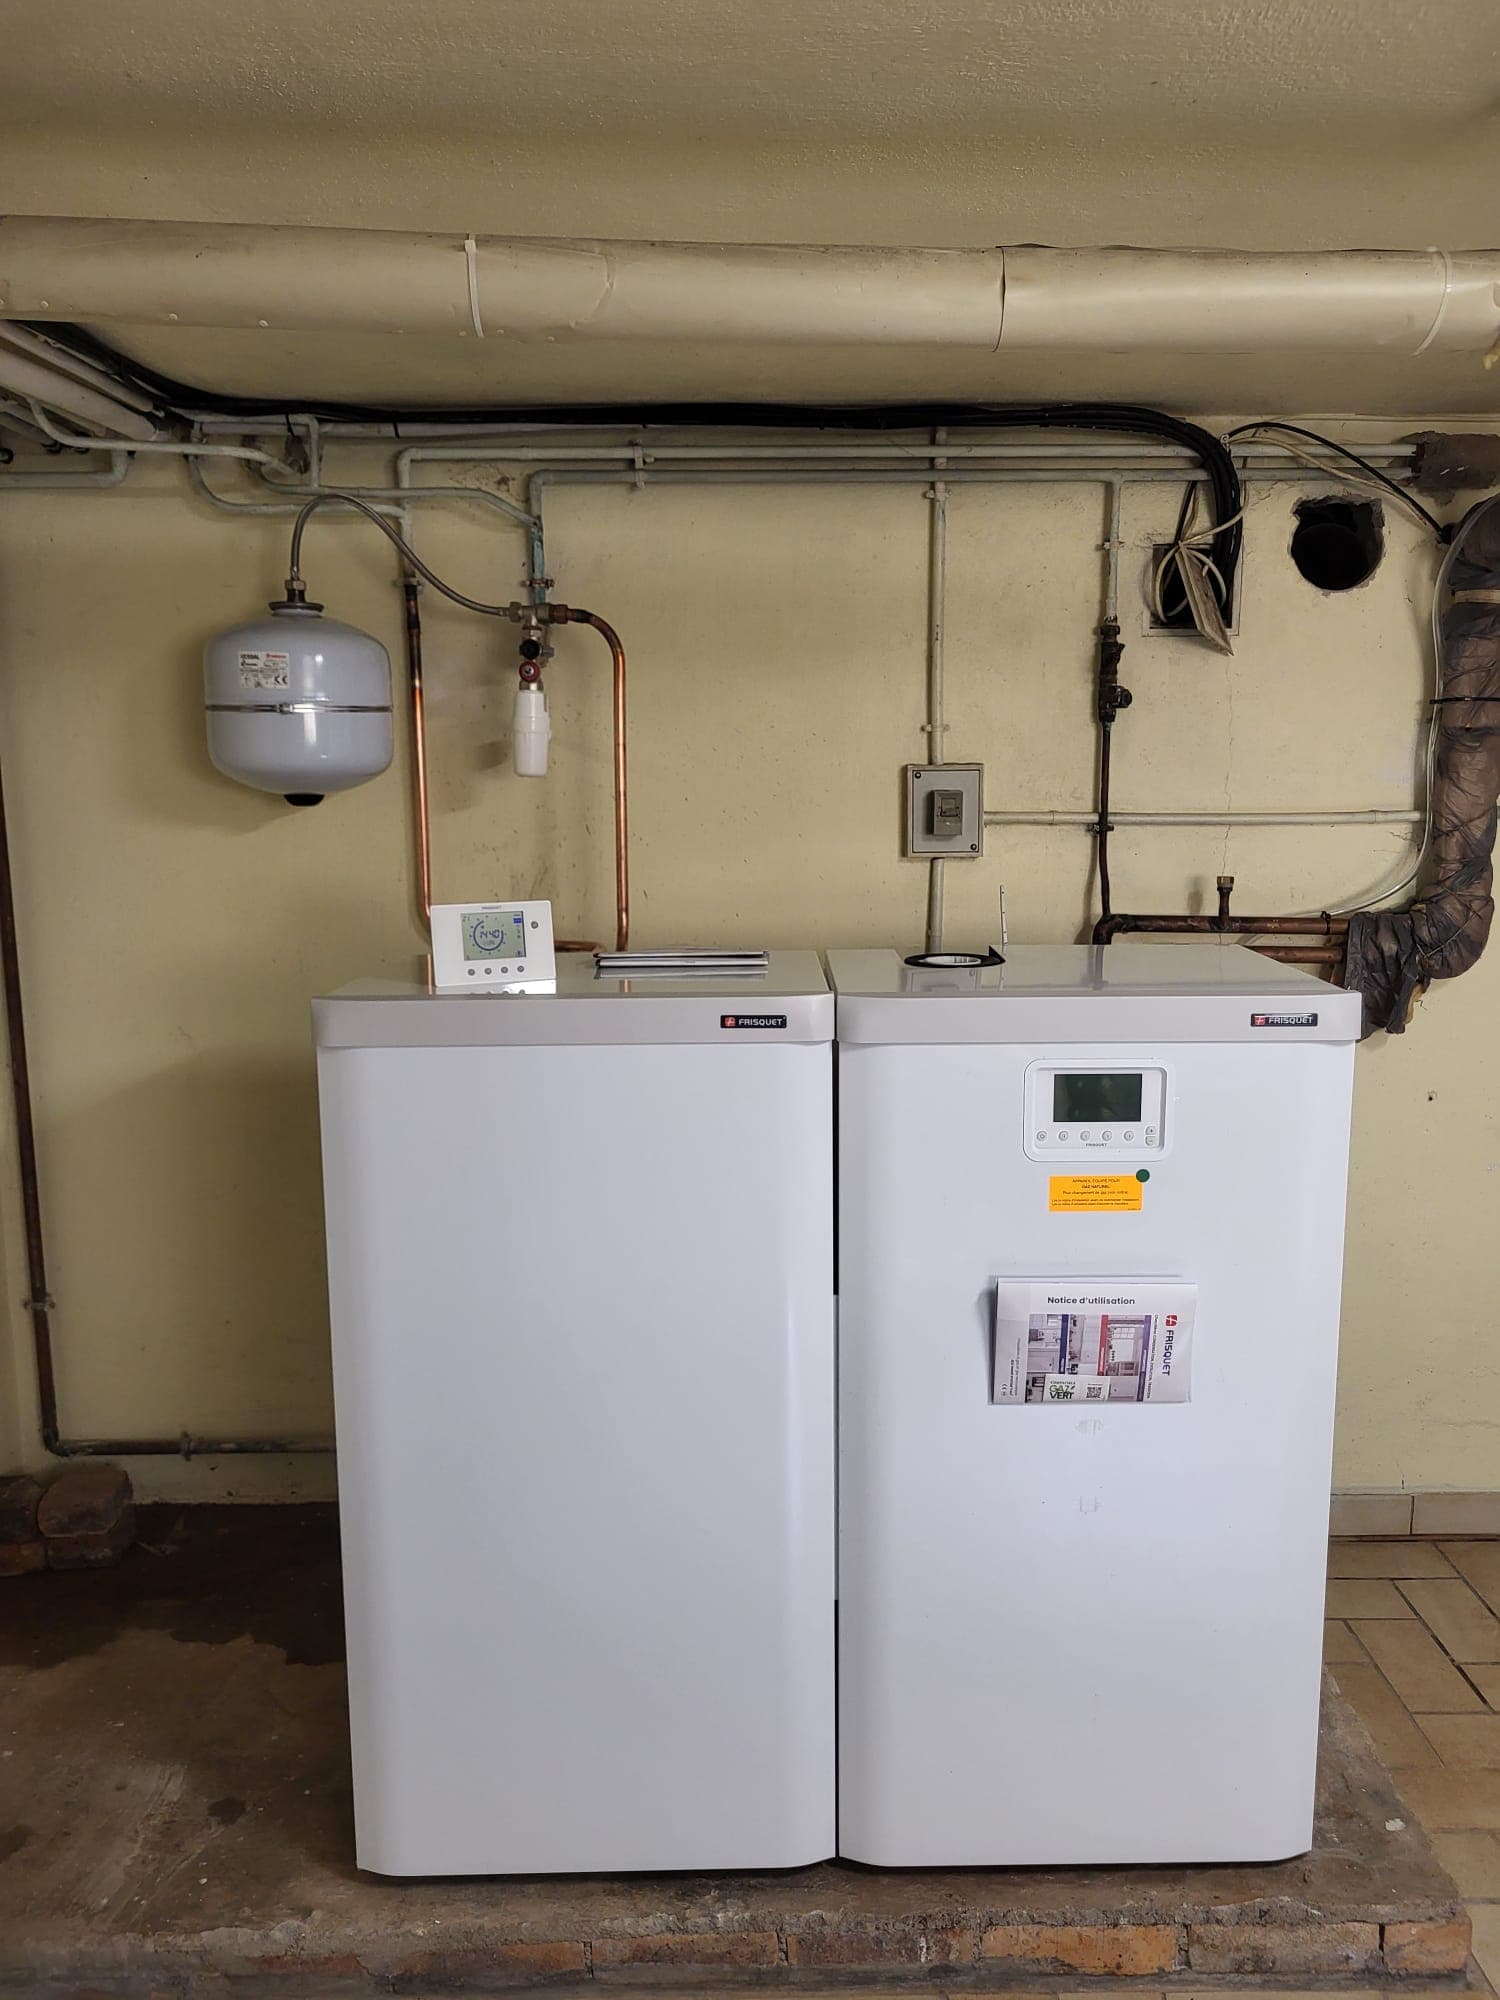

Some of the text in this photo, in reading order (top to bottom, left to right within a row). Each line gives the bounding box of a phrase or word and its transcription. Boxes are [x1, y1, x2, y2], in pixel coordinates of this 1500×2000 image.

[738, 1018, 783, 1026] FRISQUET
[1268, 1016, 1313, 1025] FRISQUET
[1047, 1296, 1136, 1305] Notice d'utilisation
[1162, 1329, 1175, 1376] FRISQUET
[1049, 1384, 1075, 1393] GAZ
[1049, 1391, 1075, 1400] VERT
